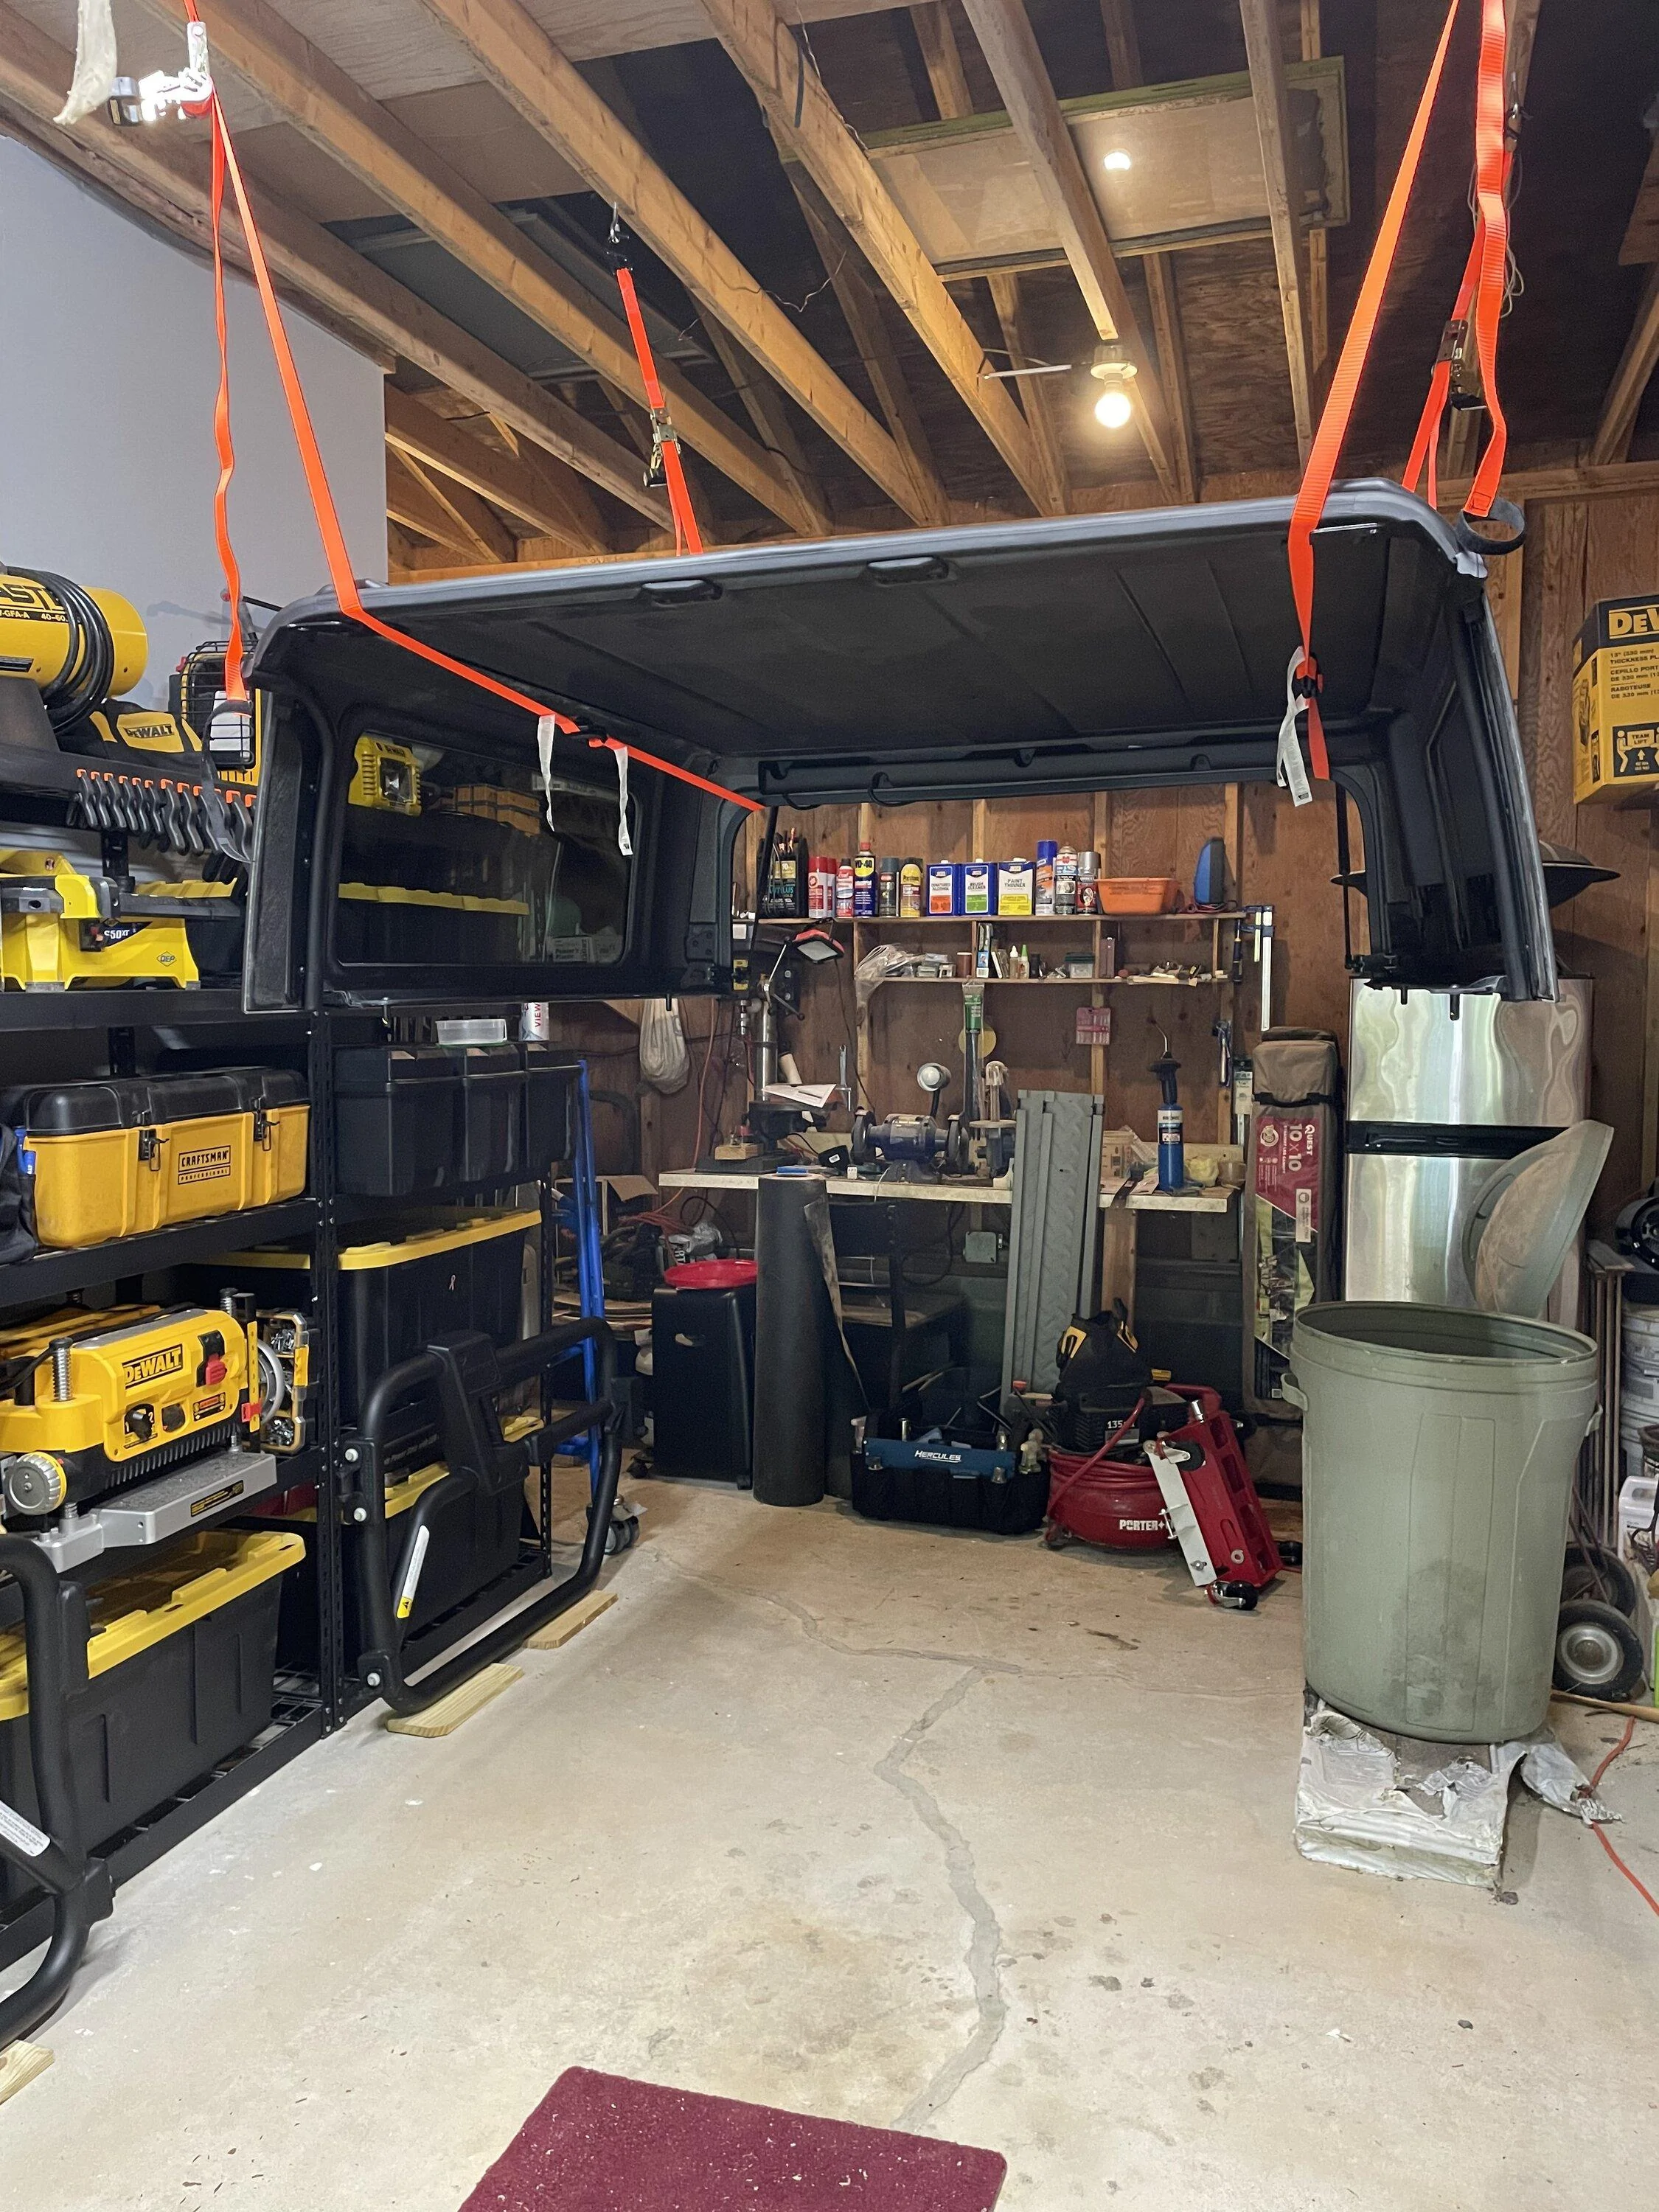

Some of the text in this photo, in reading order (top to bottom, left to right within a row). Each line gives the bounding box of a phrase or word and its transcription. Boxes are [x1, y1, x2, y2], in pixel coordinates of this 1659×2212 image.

[1610, 655, 1648, 664] THICKNESS
[1611, 684, 1651, 692] RABOTEUSE
[855, 860, 873, 868] WD-40
[1290, 1123, 1303, 1142] 10
[1304, 1124, 1315, 1156] QUEST
[181, 1151, 228, 1167] CRAFTSMAN
[1288, 1153, 1302, 1172] 10
[181, 1169, 228, 1181] PROFESSIONAL
[125, 1349, 182, 1384] DEWALT
[914, 1450, 961, 1461] HERCULES
[1119, 1519, 1158, 1531] PORTER
